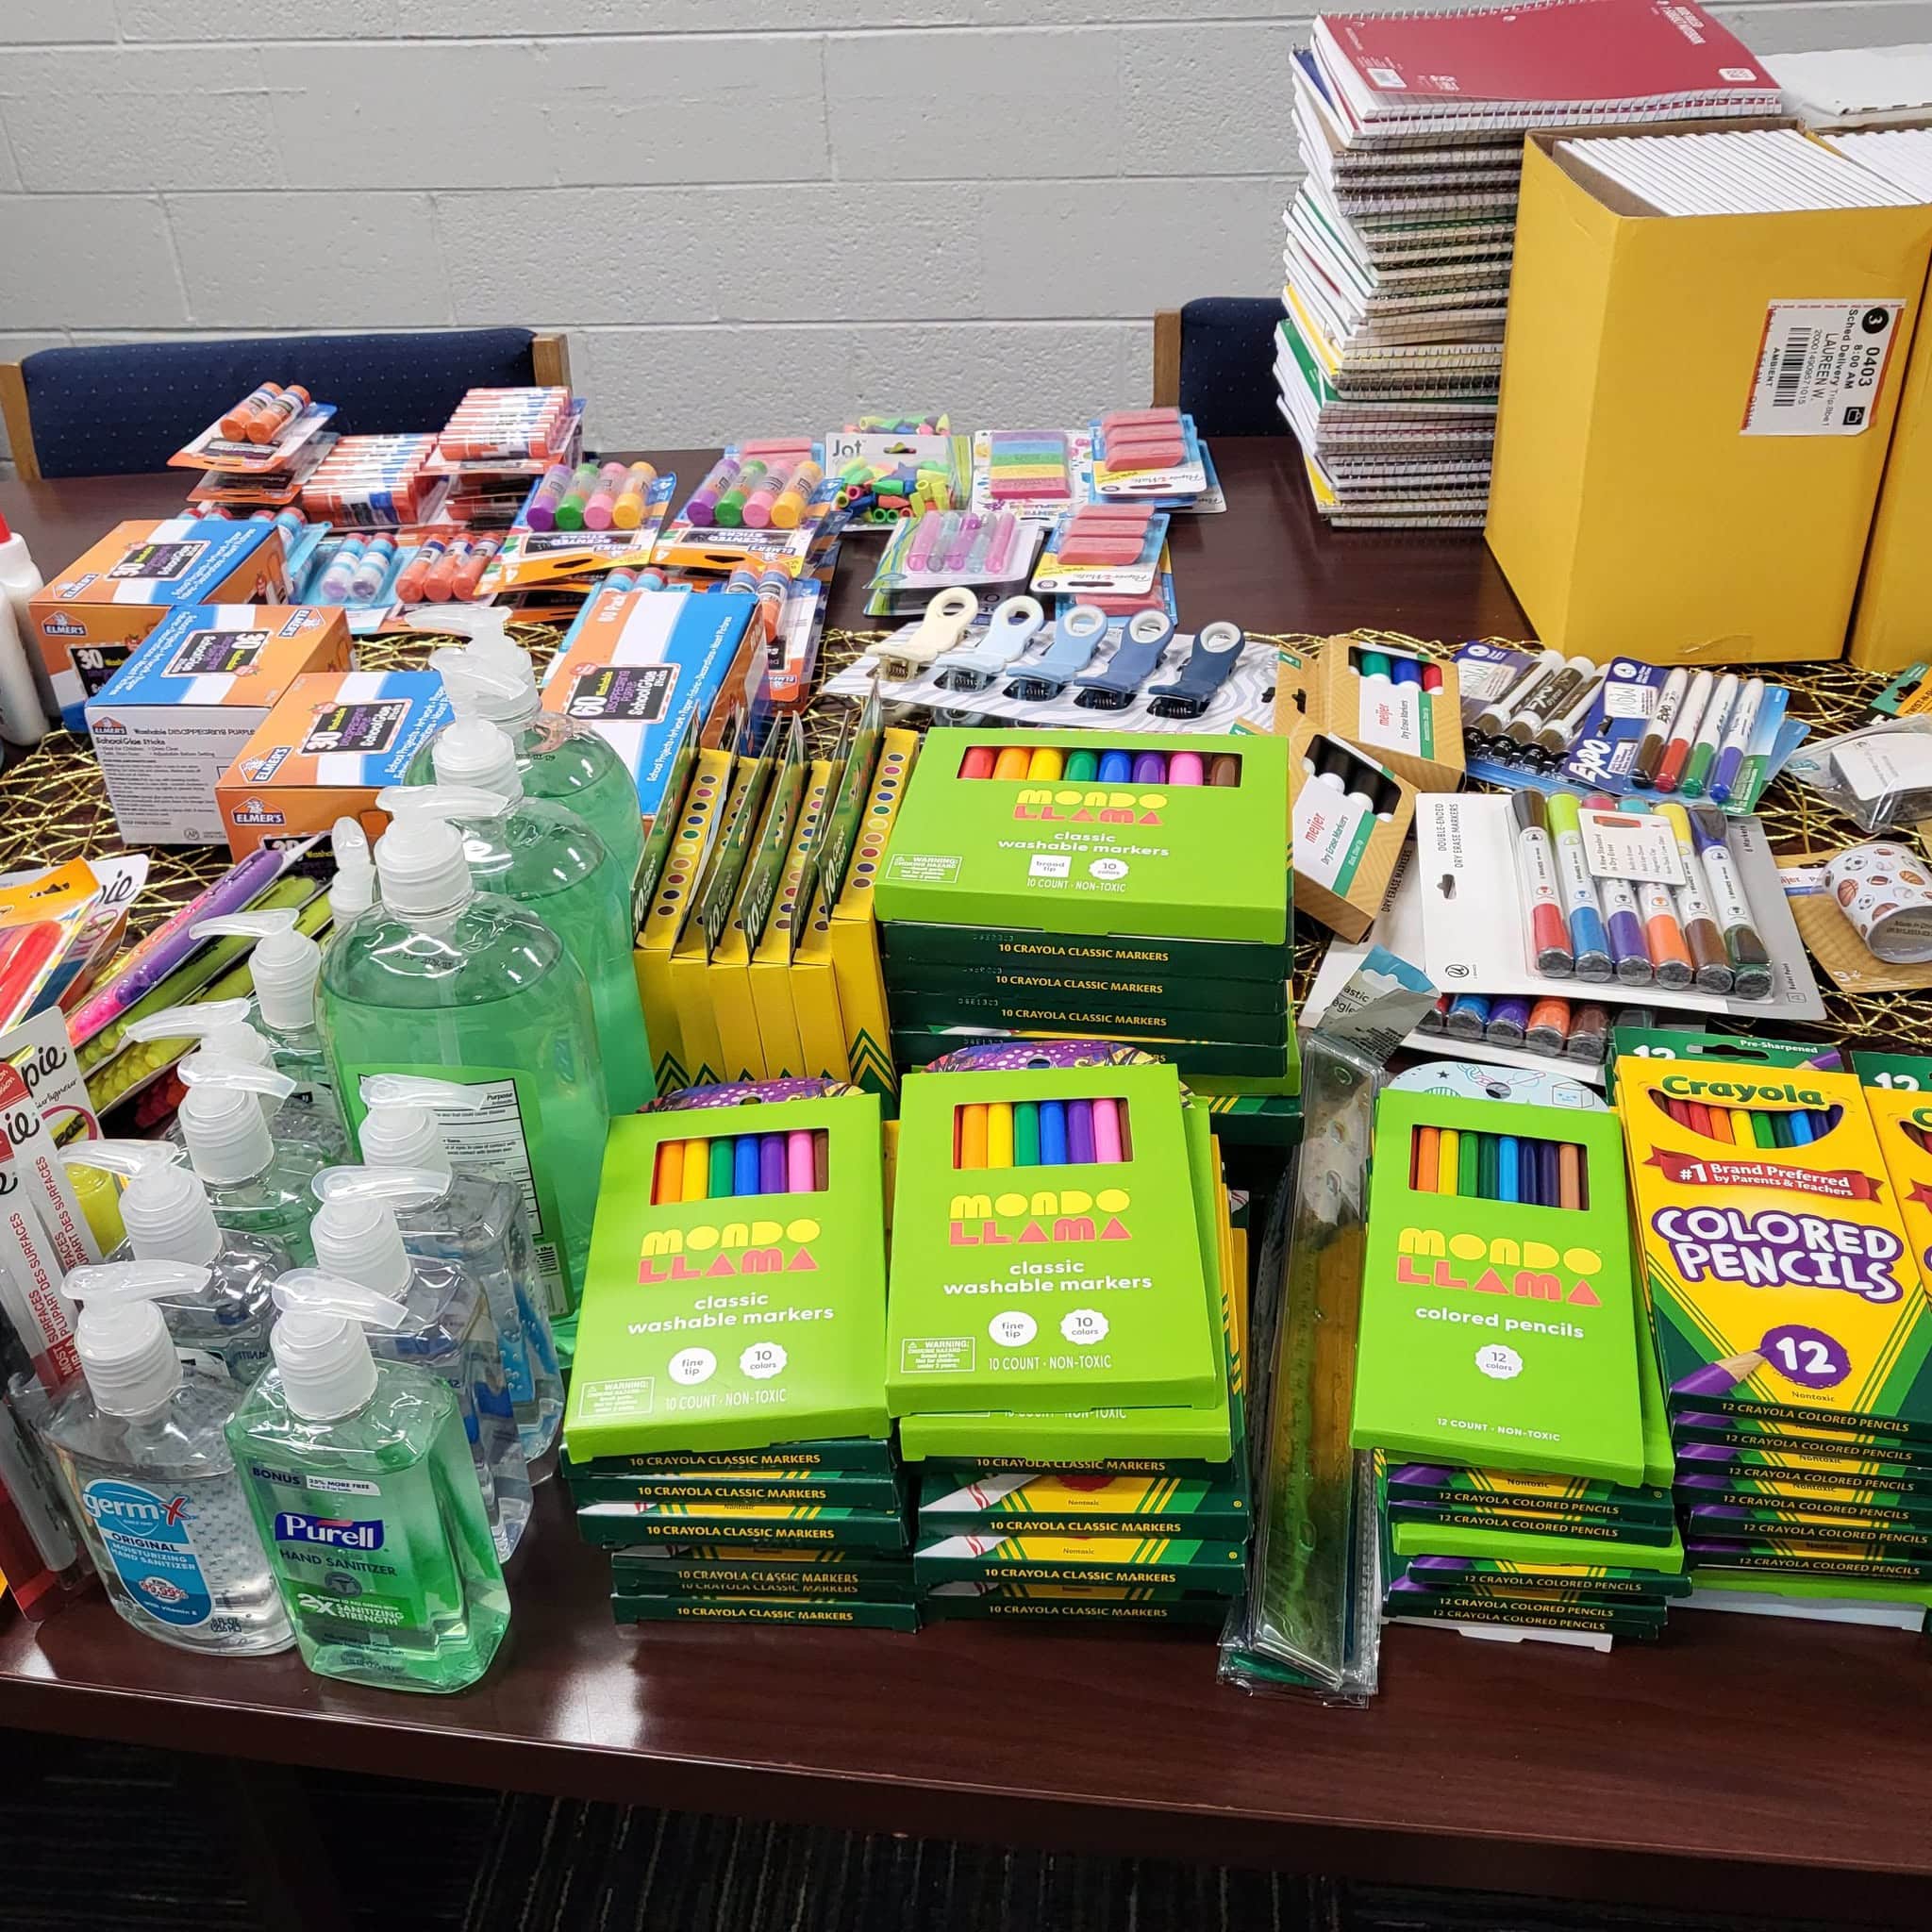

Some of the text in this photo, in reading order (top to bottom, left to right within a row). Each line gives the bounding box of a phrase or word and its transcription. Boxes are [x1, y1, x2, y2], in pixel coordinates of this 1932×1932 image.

[1868, 314, 1883, 325] 3
[1829, 308, 1858, 387] Sched Delivery
[1766, 347, 1781, 387] AMBIENT
[1810, 333, 1839, 401] LAUREEN W.
[1844, 344, 1863, 390] 8:00 AM
[1858, 347, 1880, 387] 0403
[832, 440, 862, 457] Jot
[45, 625, 85, 636] ELMER'S
[232, 633, 266, 650] 30
[76, 650, 103, 670] 30
[570, 696, 608, 716] 60
[1375, 704, 1391, 726] meijer
[1401, 718, 1409, 731] Erase
[307, 731, 343, 751] 30
[256, 747, 289, 781] ELMER'S
[1569, 739, 1611, 784] EXPO
[1017, 790, 1167, 808] MONDO
[236, 813, 282, 824] ELMER'S
[1013, 804, 1162, 825] LLAMA
[1055, 832, 1115, 841] classic
[1305, 812, 1325, 843] meijer
[1435, 803, 1447, 852] DOUBLE-ENDED
[1449, 804, 1463, 868] DRY ERASE MARKERS
[998, 841, 1169, 856] washable markers
[1321, 814, 1349, 865] Dry Erase Markers
[1027, 878, 1125, 891] 10 COUNT NON-TOXIC
[1381, 849, 1413, 912] DRY ERASE MARKERS
[999, 943, 1169, 961] 10 CRAYOLA CLASSIC MARKERS
[1010, 976, 1060, 987] CRAYOLA
[1064, 980, 1108, 991] CLASSIC
[1111, 983, 1162, 993] MARKERS
[1740, 1040, 1819, 1055] Pre-Sharpened
[487, 1091, 513, 1101] Purpose
[1661, 1074, 1825, 1108] Crayola
[1679, 1164, 1707, 1182] #1
[1710, 1163, 1850, 1188] Brand Preferred
[36, 1156, 75, 1233] DES SURFACES
[1714, 1174, 1854, 1196] by Parents & Teachers
[950, 1189, 1130, 1219] MONDO
[641, 1218, 821, 1257] MONDO
[949, 1216, 1132, 1246] LLAMA
[1657, 1209, 1897, 1258] COLORED
[1398, 1227, 1602, 1275] MONDO
[9, 1212, 69, 1337] PLUPART DES SURFACES
[638, 1246, 819, 1285] LLAMA
[1009, 1258, 1084, 1275] classic
[1675, 1242, 1896, 1300] PENCILS
[943, 1274, 1153, 1295] washable markers
[1396, 1255, 1602, 1307] LLAMA
[694, 1292, 769, 1310] classic
[628, 1306, 834, 1336] washable markers
[1002, 1322, 1024, 1330] fine
[1076, 1317, 1092, 1327] 10
[1416, 1306, 1584, 1339] colored pencils
[28, 1290, 75, 1376] MOST SURFACES
[1006, 1329, 1021, 1339] tip
[925, 1340, 969, 1348] WARNING:
[682, 1358, 704, 1367] fine
[750, 1361, 776, 1371] colors
[756, 1350, 772, 1361] 10
[990, 1355, 1111, 1371] 10 COUNT NON-TOXIC
[1492, 1352, 1507, 1362] 12
[1775, 1337, 1837, 1374] 12
[684, 1367, 700, 1376] tip
[1486, 1362, 1513, 1372] colors
[604, 1380, 649, 1391] WARNING:
[665, 1397, 676, 1411] 10
[679, 1394, 717, 1411] COUNT
[725, 1389, 787, 1406] NON-TOXIC
[1792, 1391, 1834, 1402] Nontoxic
[1722, 1403, 1909, 1432] 12 CRAYOLA COLORED PENCILS
[1437, 1418, 1560, 1441] 12 COUNT NON-TOXIC
[1741, 1436, 1797, 1449] CRAYOLA
[1802, 1442, 1859, 1455] COLORED
[1862, 1448, 1912, 1460] PENCILS
[252, 1467, 302, 1486] BONUS
[327, 1480, 351, 1489] MORE
[1507, 1478, 1550, 1489] Nontoxic
[639, 1487, 826, 1499] 10 CRAYOLA CLASSIC MARKERS
[1455, 1493, 1509, 1506] CRAYOLA
[1512, 1498, 1569, 1510] COLORED
[1572, 1504, 1619, 1514] PENCILS
[284, 1513, 375, 1549] Purell
[647, 1525, 834, 1539] 10 CRAYOLA CLASSIC MARKERS
[991, 1522, 1181, 1532] 10 CRAYOLA CLASSIC MARKERS
[111, 1532, 180, 1553] ORIGINAL
[112, 1542, 188, 1563] MOISTURIZING
[110, 1549, 196, 1571] HAND SANITIZER
[279, 1548, 397, 1576] HAND SANITIZER
[336, 1603, 405, 1620] SANITIZING
[339, 1611, 398, 1626] STRENGTH
